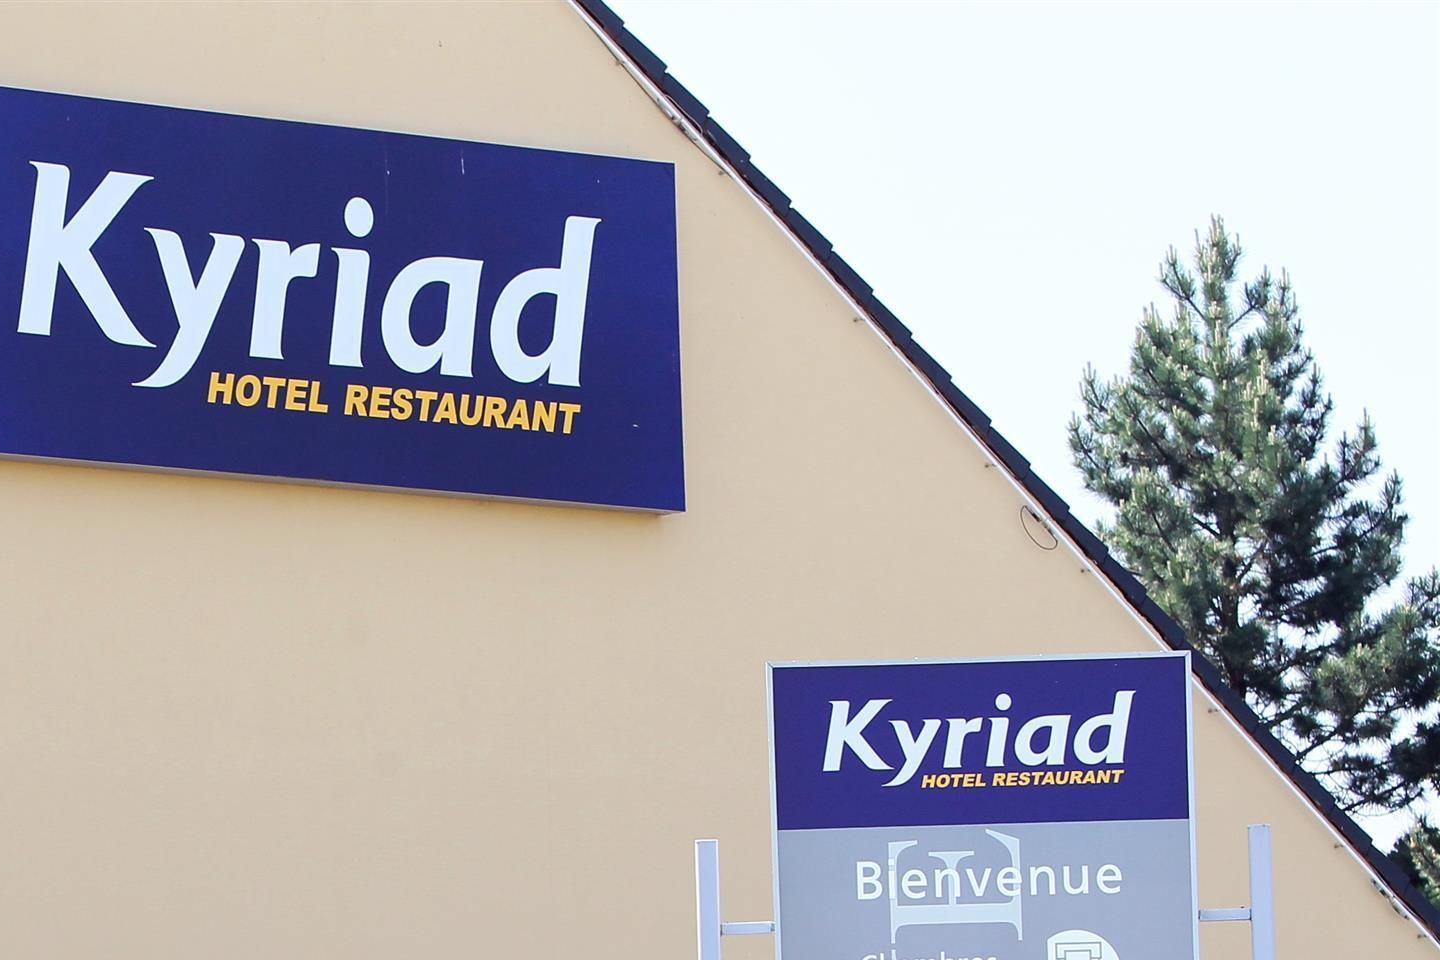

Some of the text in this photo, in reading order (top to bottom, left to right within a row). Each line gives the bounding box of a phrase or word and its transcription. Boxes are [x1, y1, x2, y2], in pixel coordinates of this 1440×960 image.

[17, 160, 602, 388] Kyriad
[208, 372, 581, 434] HOTEL RESTAURANT
[822, 690, 1136, 786] Kyriad
[921, 769, 1125, 788] HOTEL RESTAURANT
[856, 859, 1123, 899] Bienvenue
